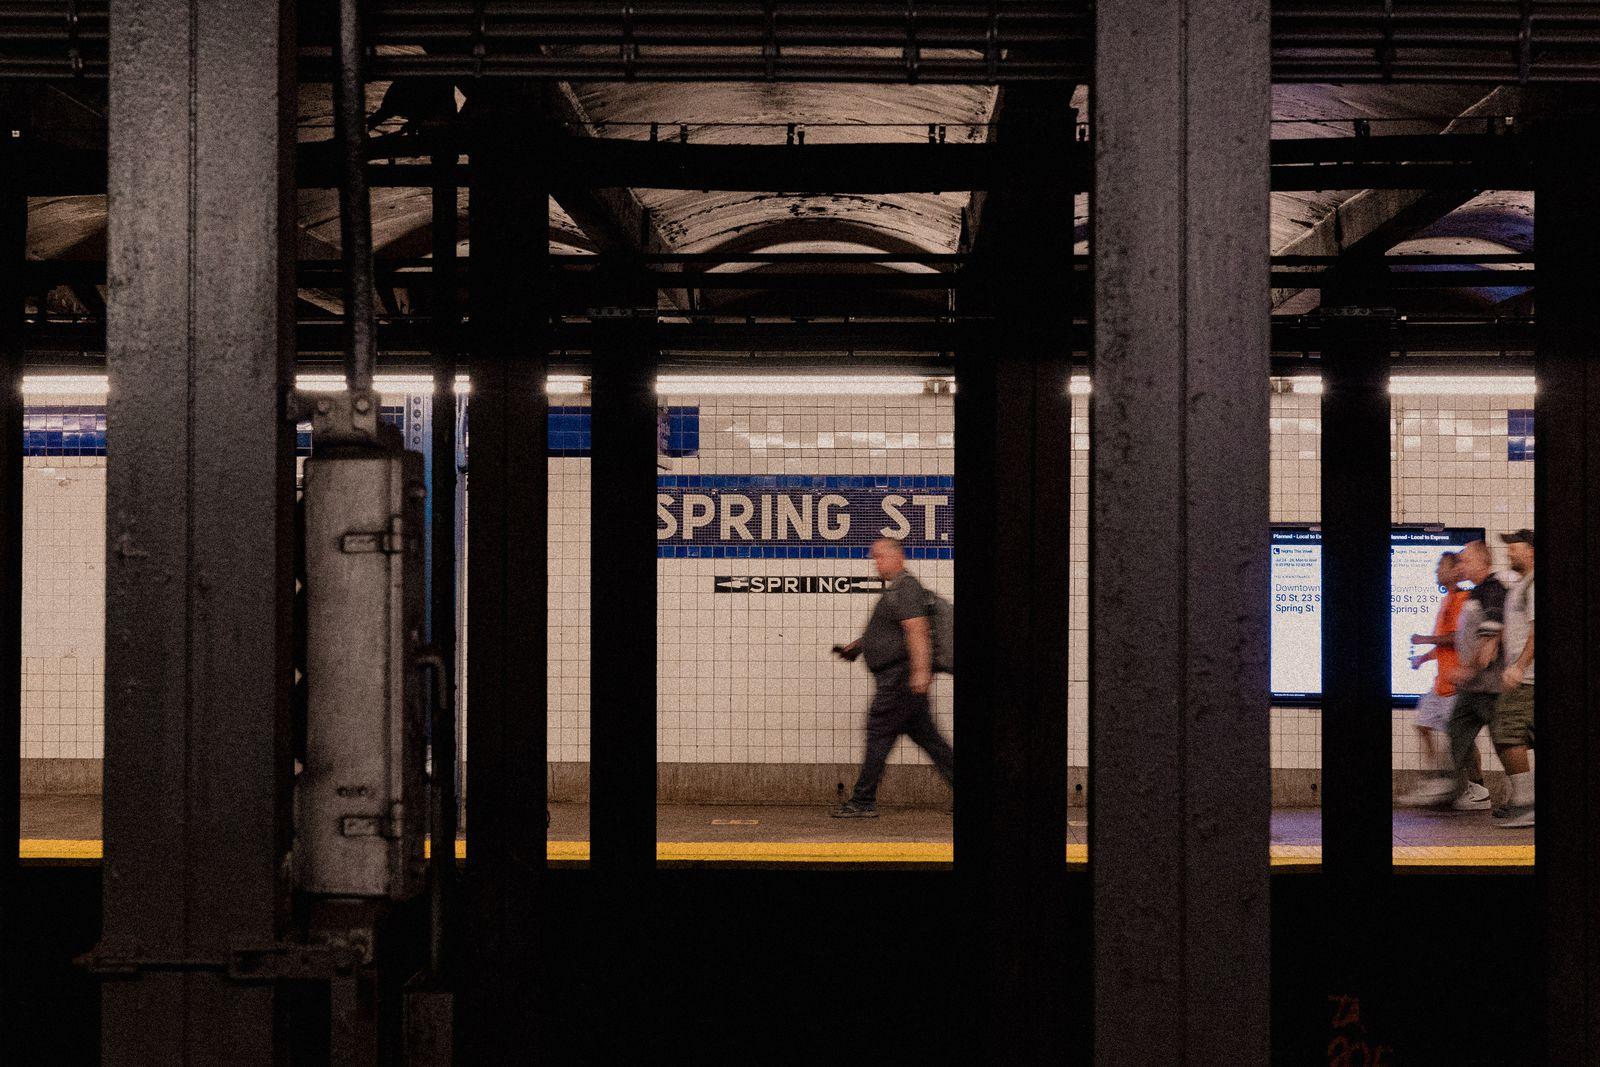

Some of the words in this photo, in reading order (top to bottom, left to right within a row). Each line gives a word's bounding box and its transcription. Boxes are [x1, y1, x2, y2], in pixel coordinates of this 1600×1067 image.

[656, 493, 851, 541] SPRING
[879, 494, 949, 541] ST.
[749, 577, 851, 593] SPRING
[1275, 583, 1320, 592] Downtown
[1275, 593, 1287, 602] 50
[1302, 593, 1313, 602] 23
[1314, 593, 1321, 602] S
[1416, 594, 1427, 603] 23
[1429, 594, 1439, 603] St
[1275, 604, 1303, 614] Spring
[1305, 604, 1315, 613] St
[1391, 605, 1418, 614] Spring
[1420, 605, 1429, 613] St
